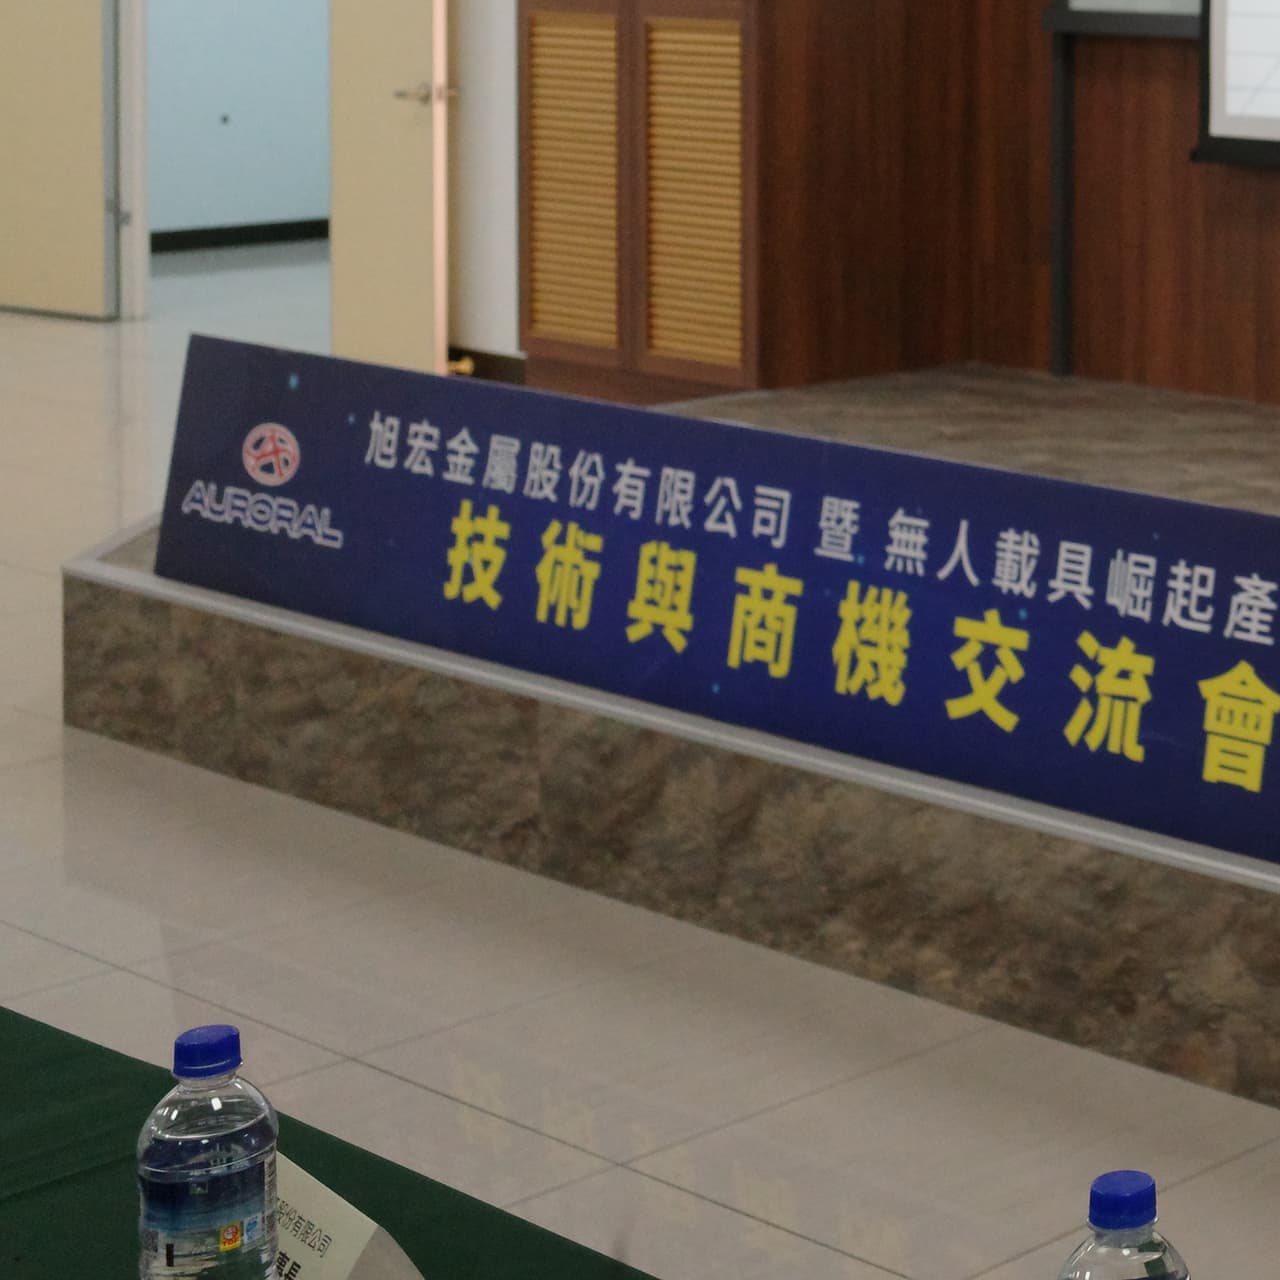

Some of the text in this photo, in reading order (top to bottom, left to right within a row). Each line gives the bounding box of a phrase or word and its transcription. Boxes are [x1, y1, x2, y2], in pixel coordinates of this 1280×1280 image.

[181, 480, 344, 549] AURORAL
[363, 410, 792, 549] 旭宏金屬股份有限公司
[817, 495, 861, 563] 暨
